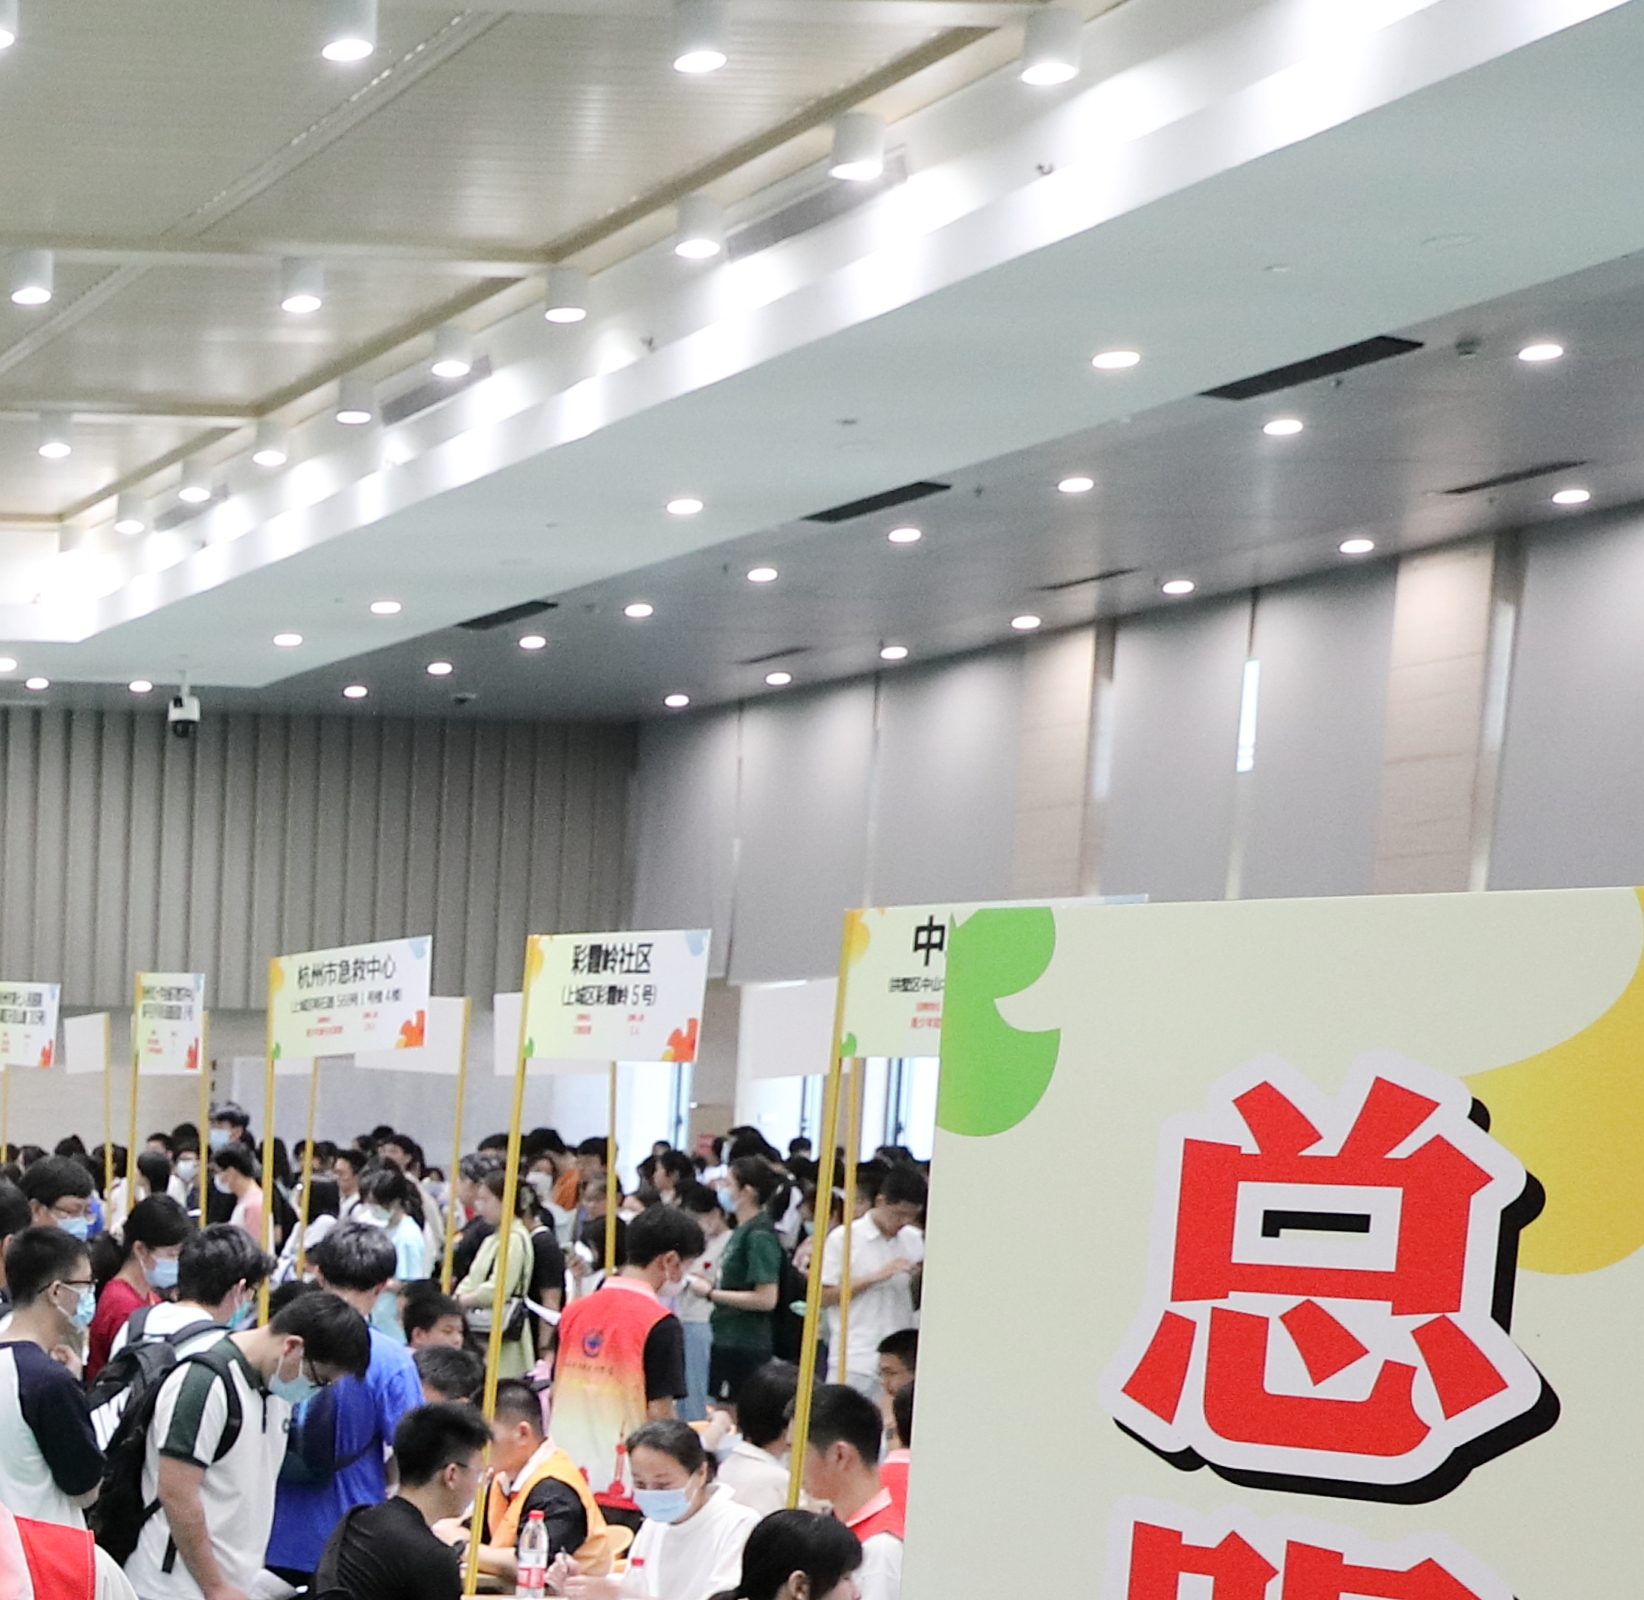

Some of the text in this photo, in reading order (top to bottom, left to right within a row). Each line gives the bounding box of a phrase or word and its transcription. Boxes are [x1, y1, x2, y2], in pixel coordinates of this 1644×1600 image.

[913, 915, 945, 966] 中
[298, 954, 396, 989] 杭州市急救中心
[572, 943, 654, 974] 彩霞岭社区
